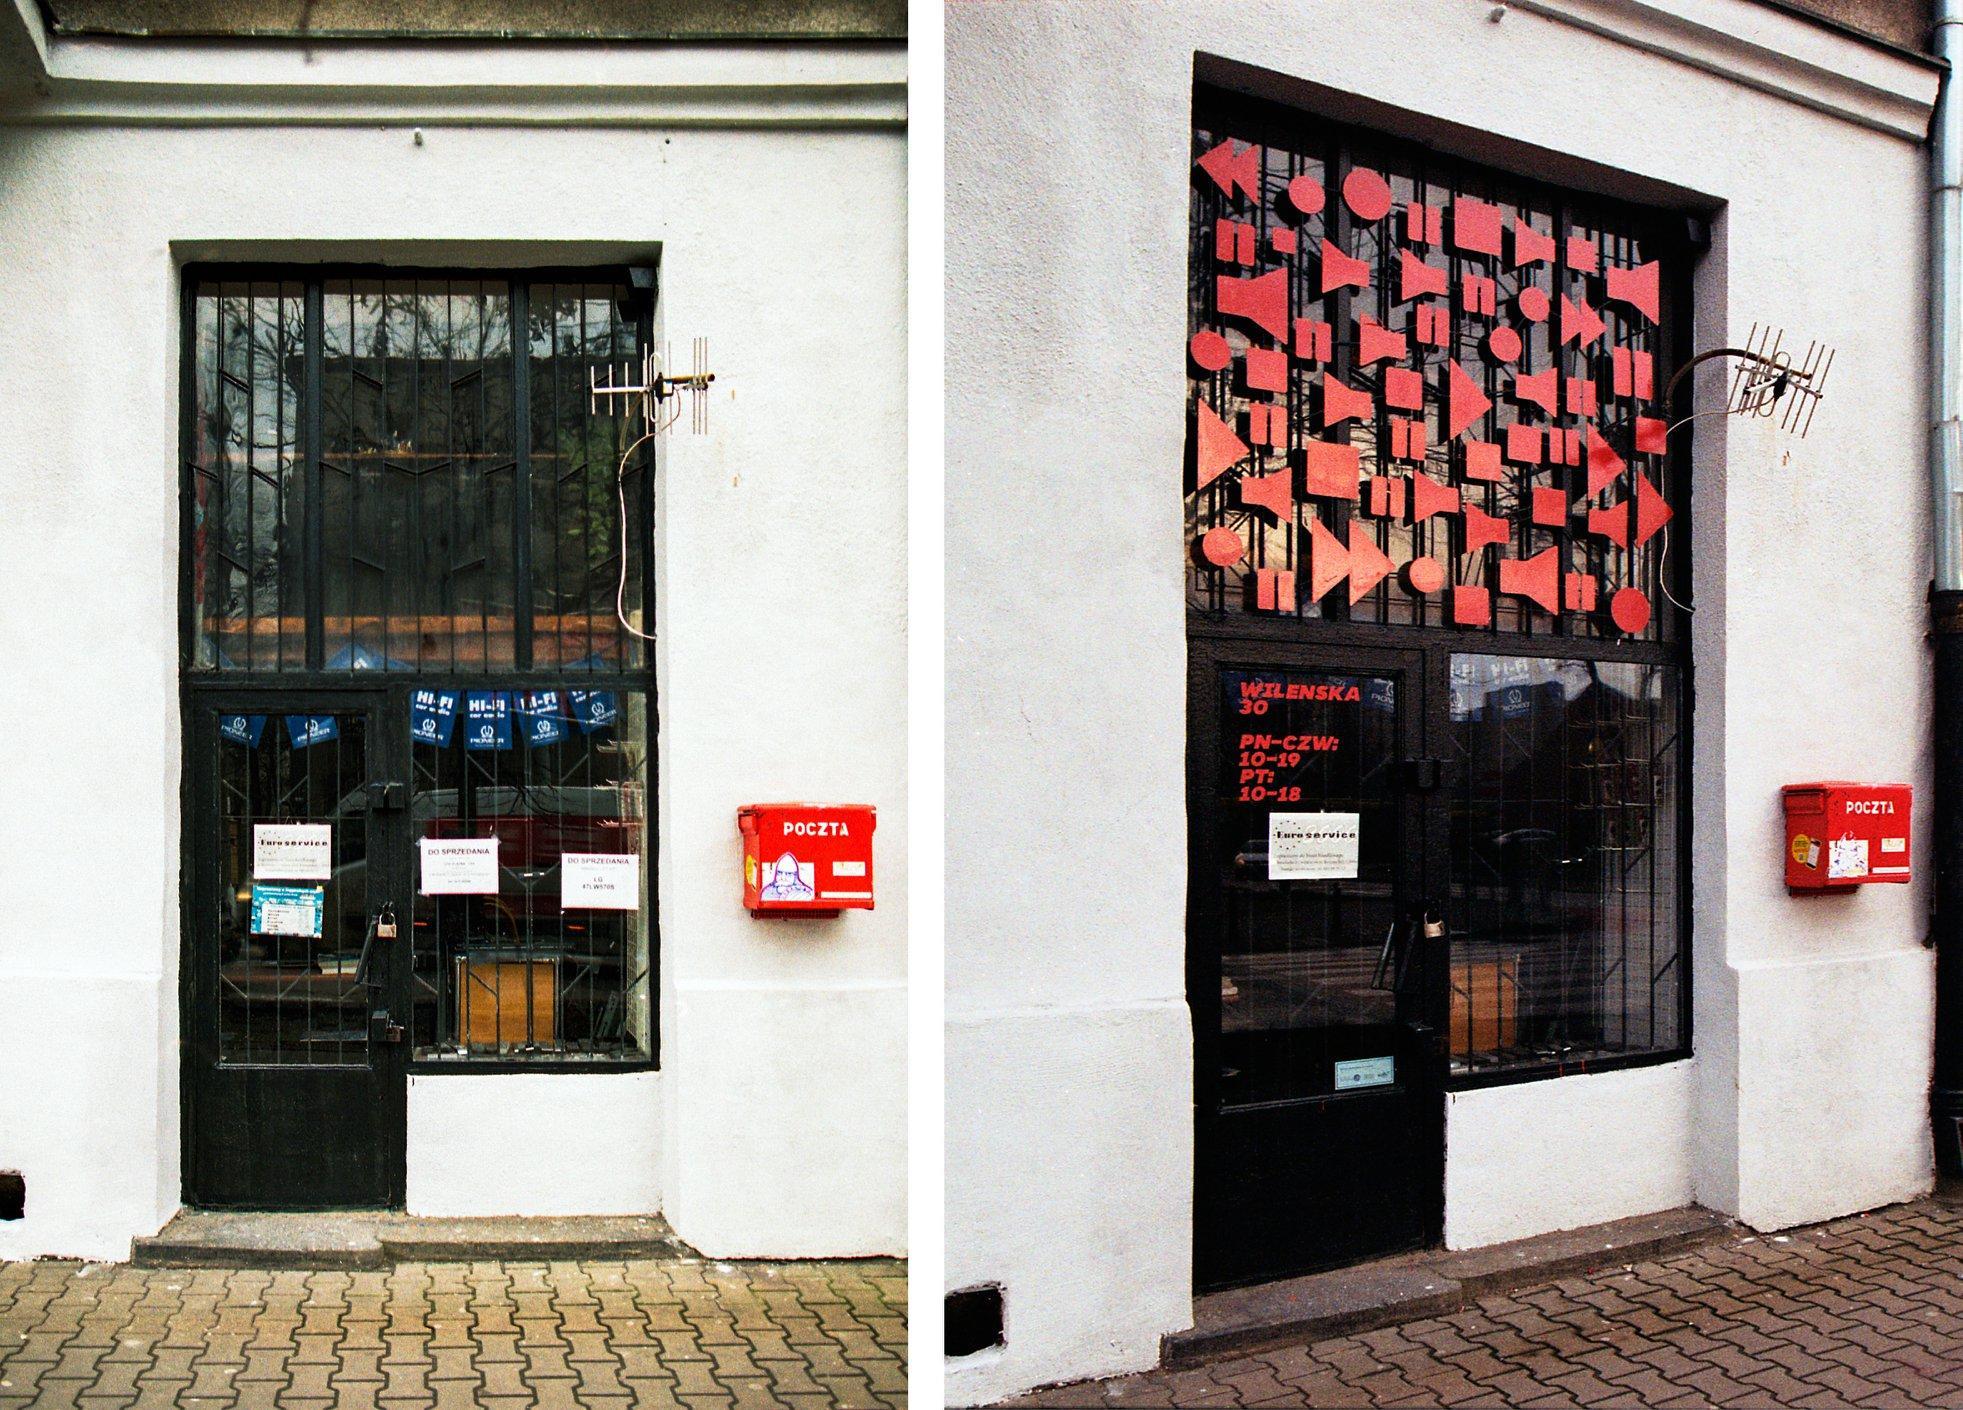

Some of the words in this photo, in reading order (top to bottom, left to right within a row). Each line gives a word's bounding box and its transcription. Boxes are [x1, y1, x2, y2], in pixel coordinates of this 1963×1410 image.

[1240, 682, 1360, 702] WILENSKA
[1239, 699, 1269, 715] 30
[1239, 734, 1340, 752] PN-CZW:
[1238, 751, 1301, 768] 10-19
[1239, 768, 1275, 784] PT:
[1238, 786, 1302, 802] 10-18
[1845, 801, 1895, 814] POCZTA
[783, 821, 849, 837] POCZTA
[427, 848, 440, 856] DO
[580, 857, 630, 865] SPRZEDANIA
